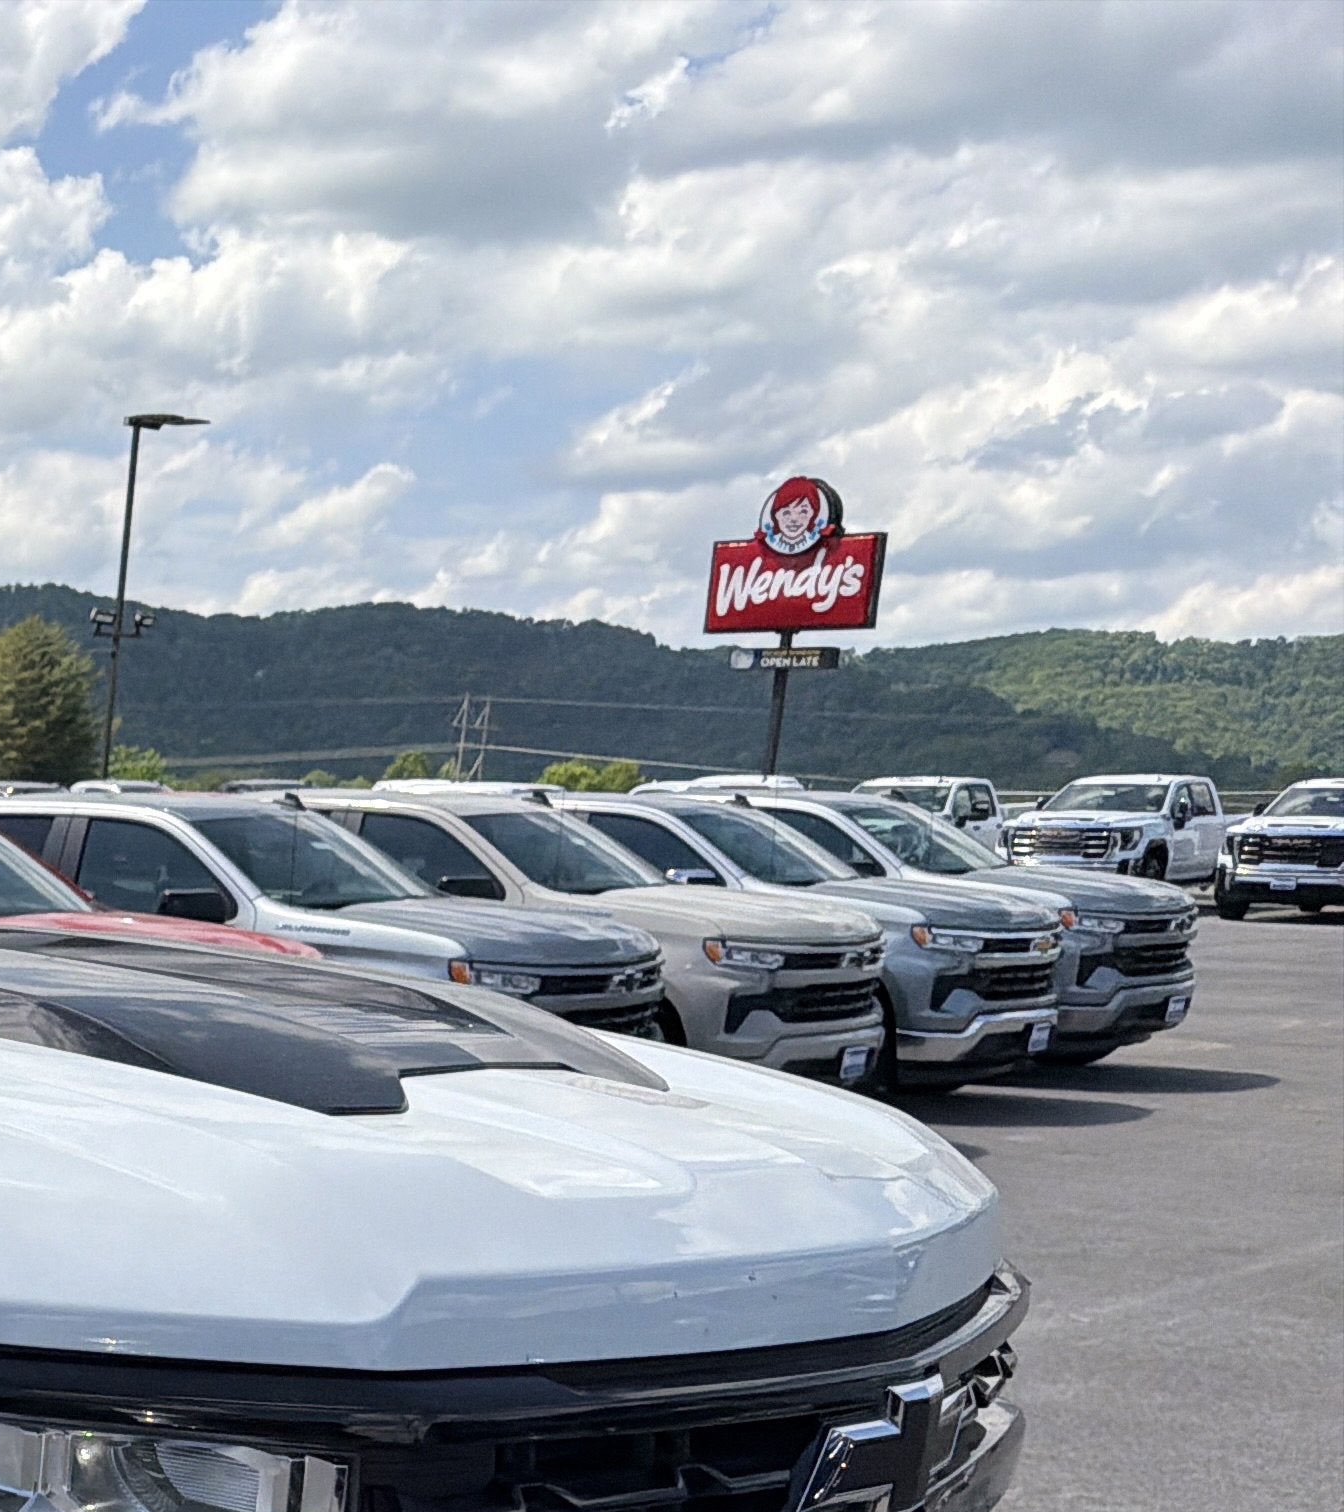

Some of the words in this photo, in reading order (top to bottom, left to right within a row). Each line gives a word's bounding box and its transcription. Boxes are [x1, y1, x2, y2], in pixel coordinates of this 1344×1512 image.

[715, 548, 865, 617] Wendy's
[760, 656, 791, 668] OPEN
[792, 655, 820, 667] LATE
